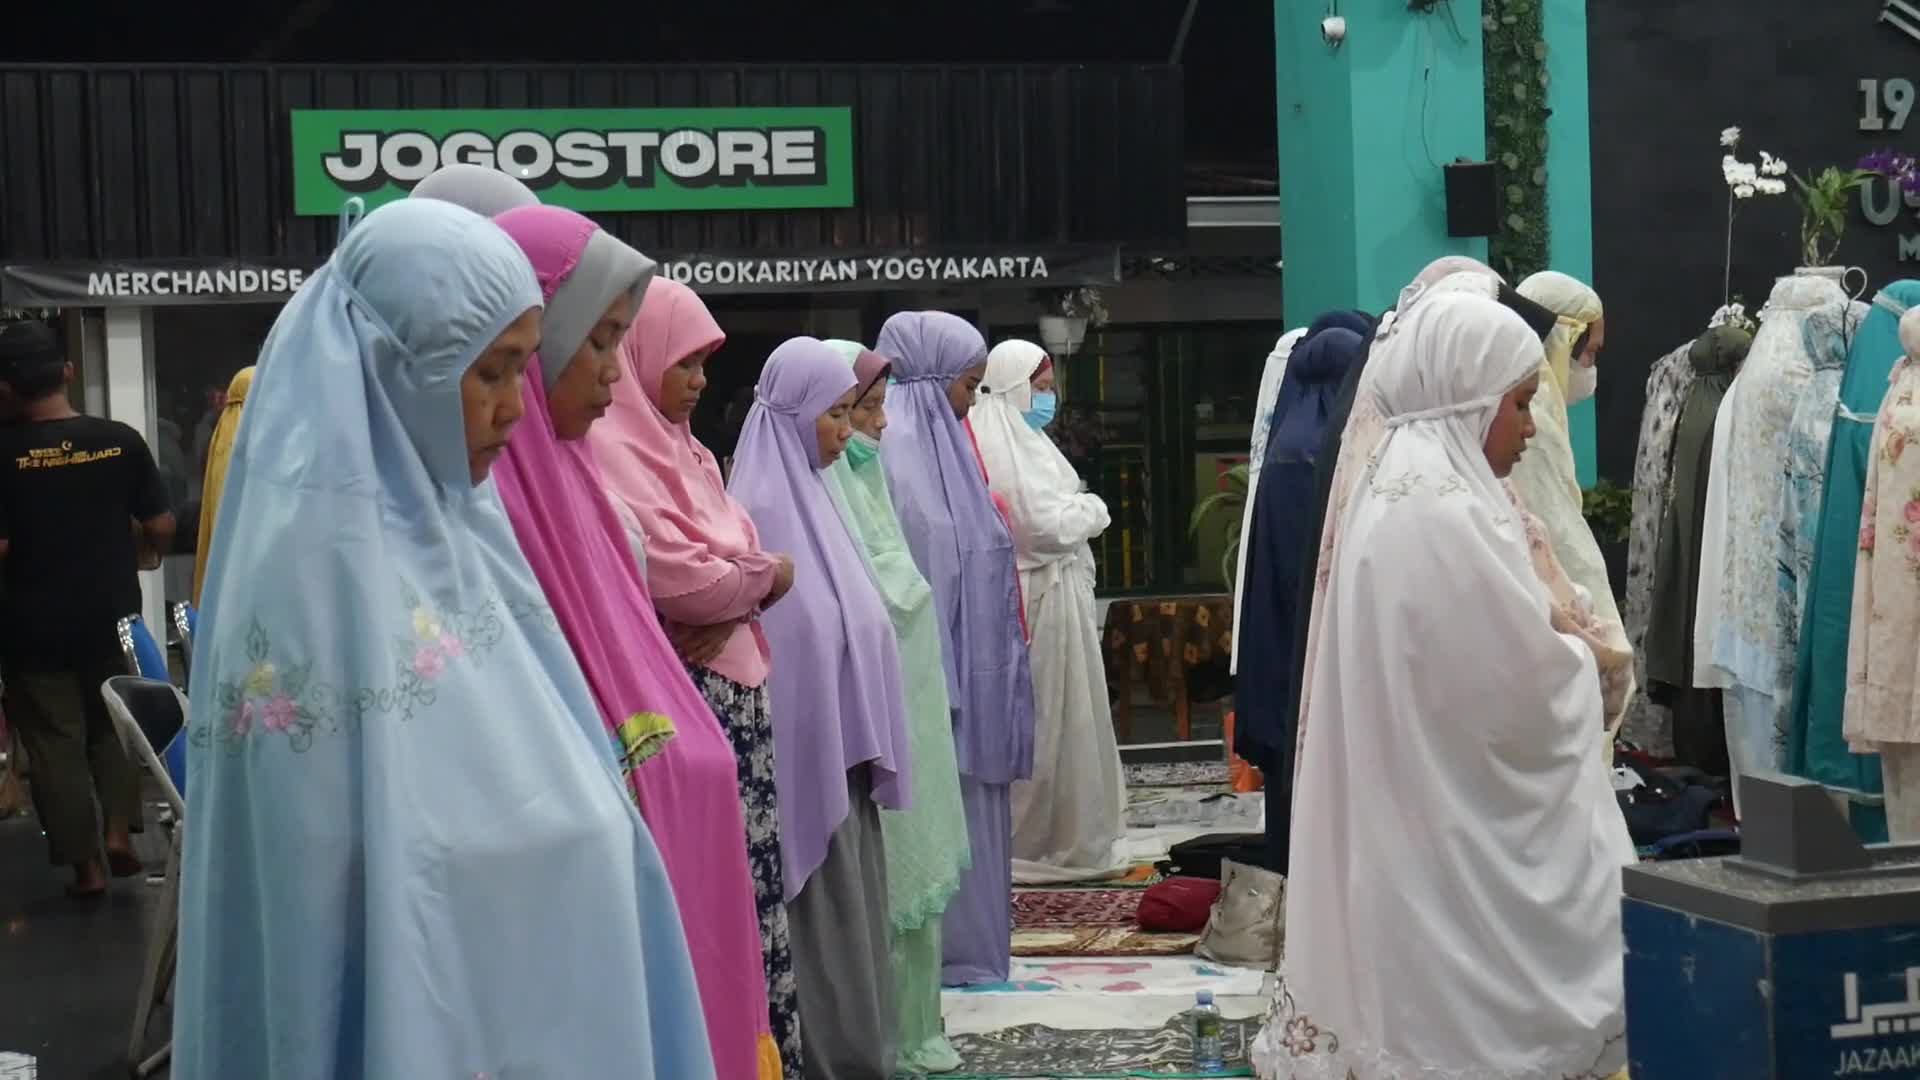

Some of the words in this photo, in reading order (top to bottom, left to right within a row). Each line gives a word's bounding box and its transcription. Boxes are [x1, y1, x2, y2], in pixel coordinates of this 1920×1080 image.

[1858, 78, 1915, 130] 19
[324, 129, 817, 182] JOGOSTORE
[87, 269, 303, 295] MERCHANDISE
[663, 258, 857, 284] JOGOKARIYAN
[867, 256, 1049, 281] YOGYAKARTA
